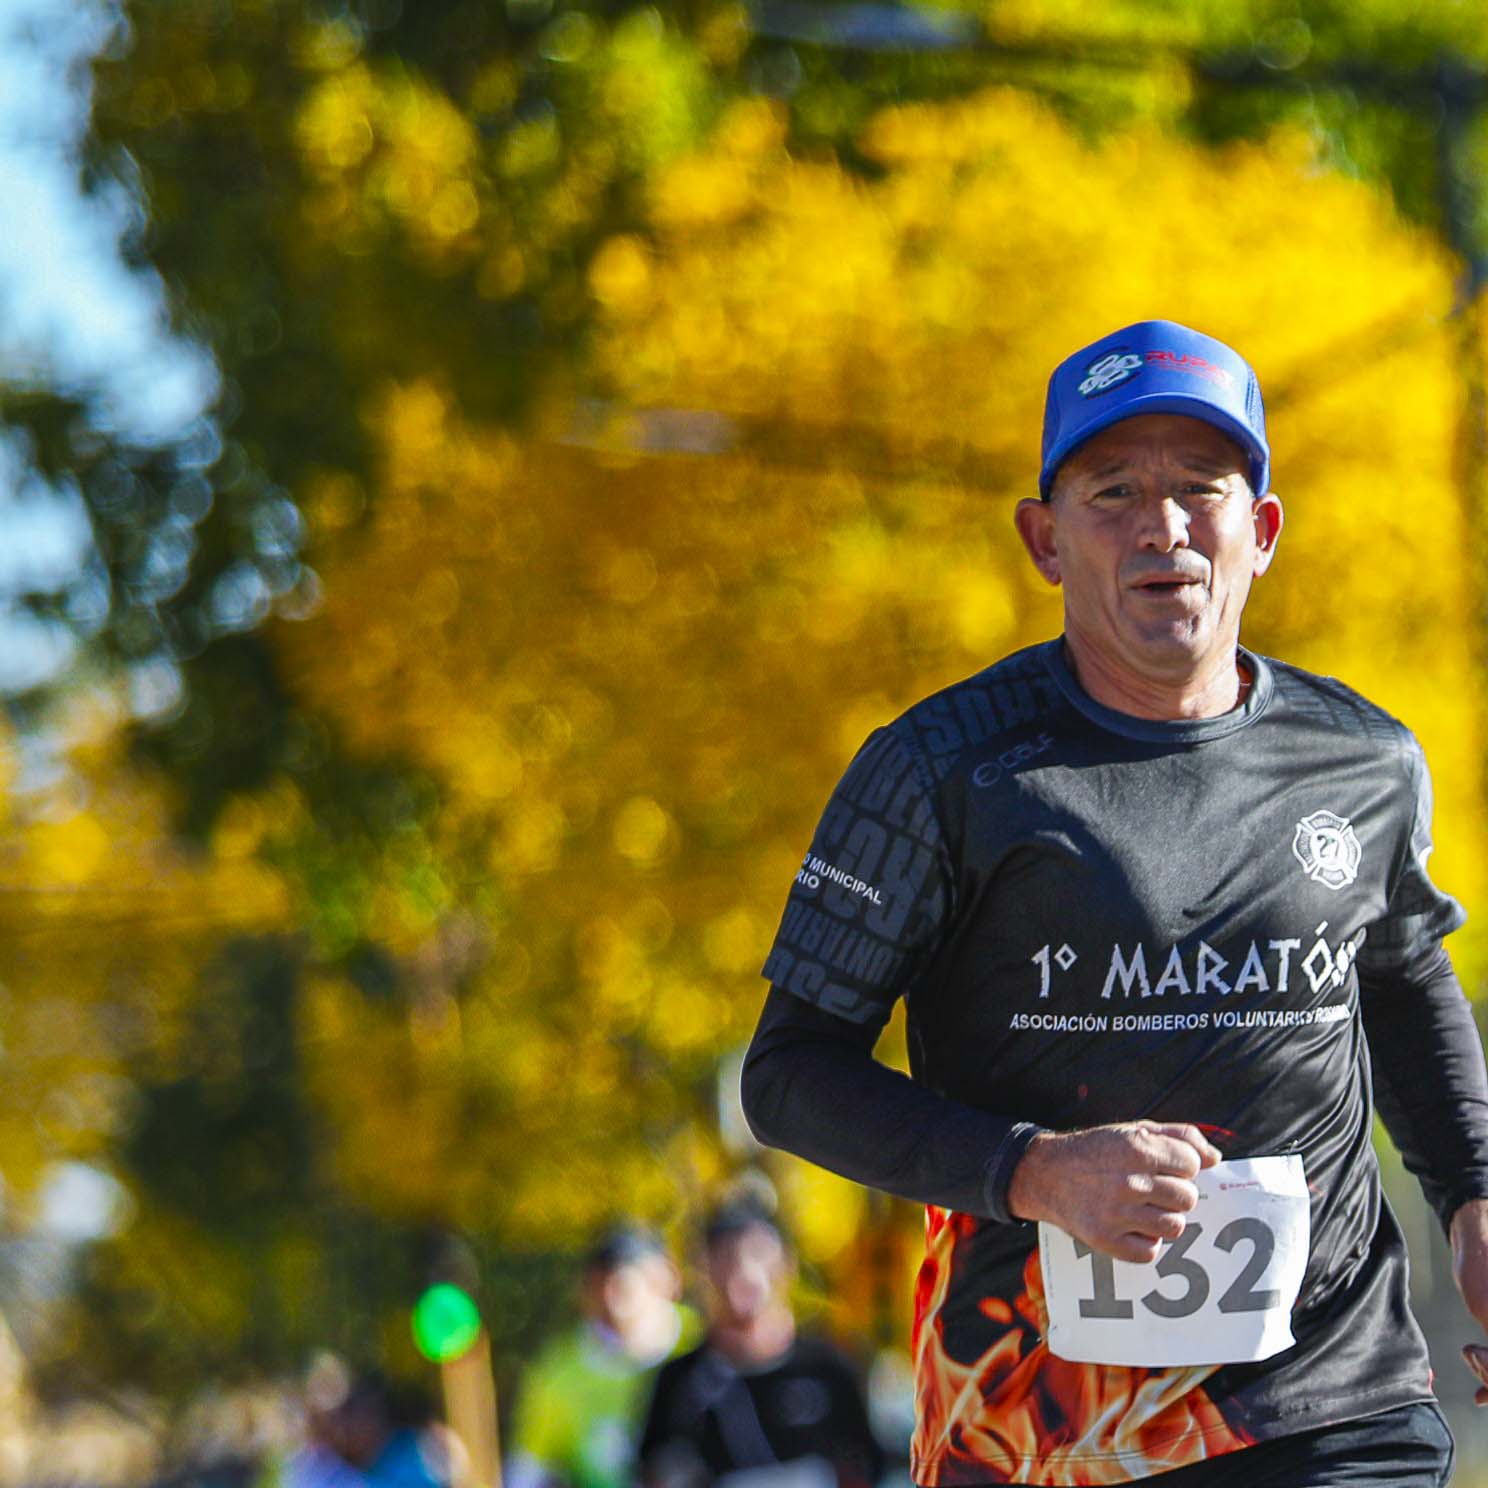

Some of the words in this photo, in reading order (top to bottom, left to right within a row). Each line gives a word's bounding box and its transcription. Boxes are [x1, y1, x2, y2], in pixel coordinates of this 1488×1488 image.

[809, 856, 882, 906] MUNICIPAL
[1009, 1012, 1108, 1032] ASOCIACIÓN
[1112, 1012, 1209, 1031] BOMBEROS
[1072, 1216, 1281, 1320] 132
